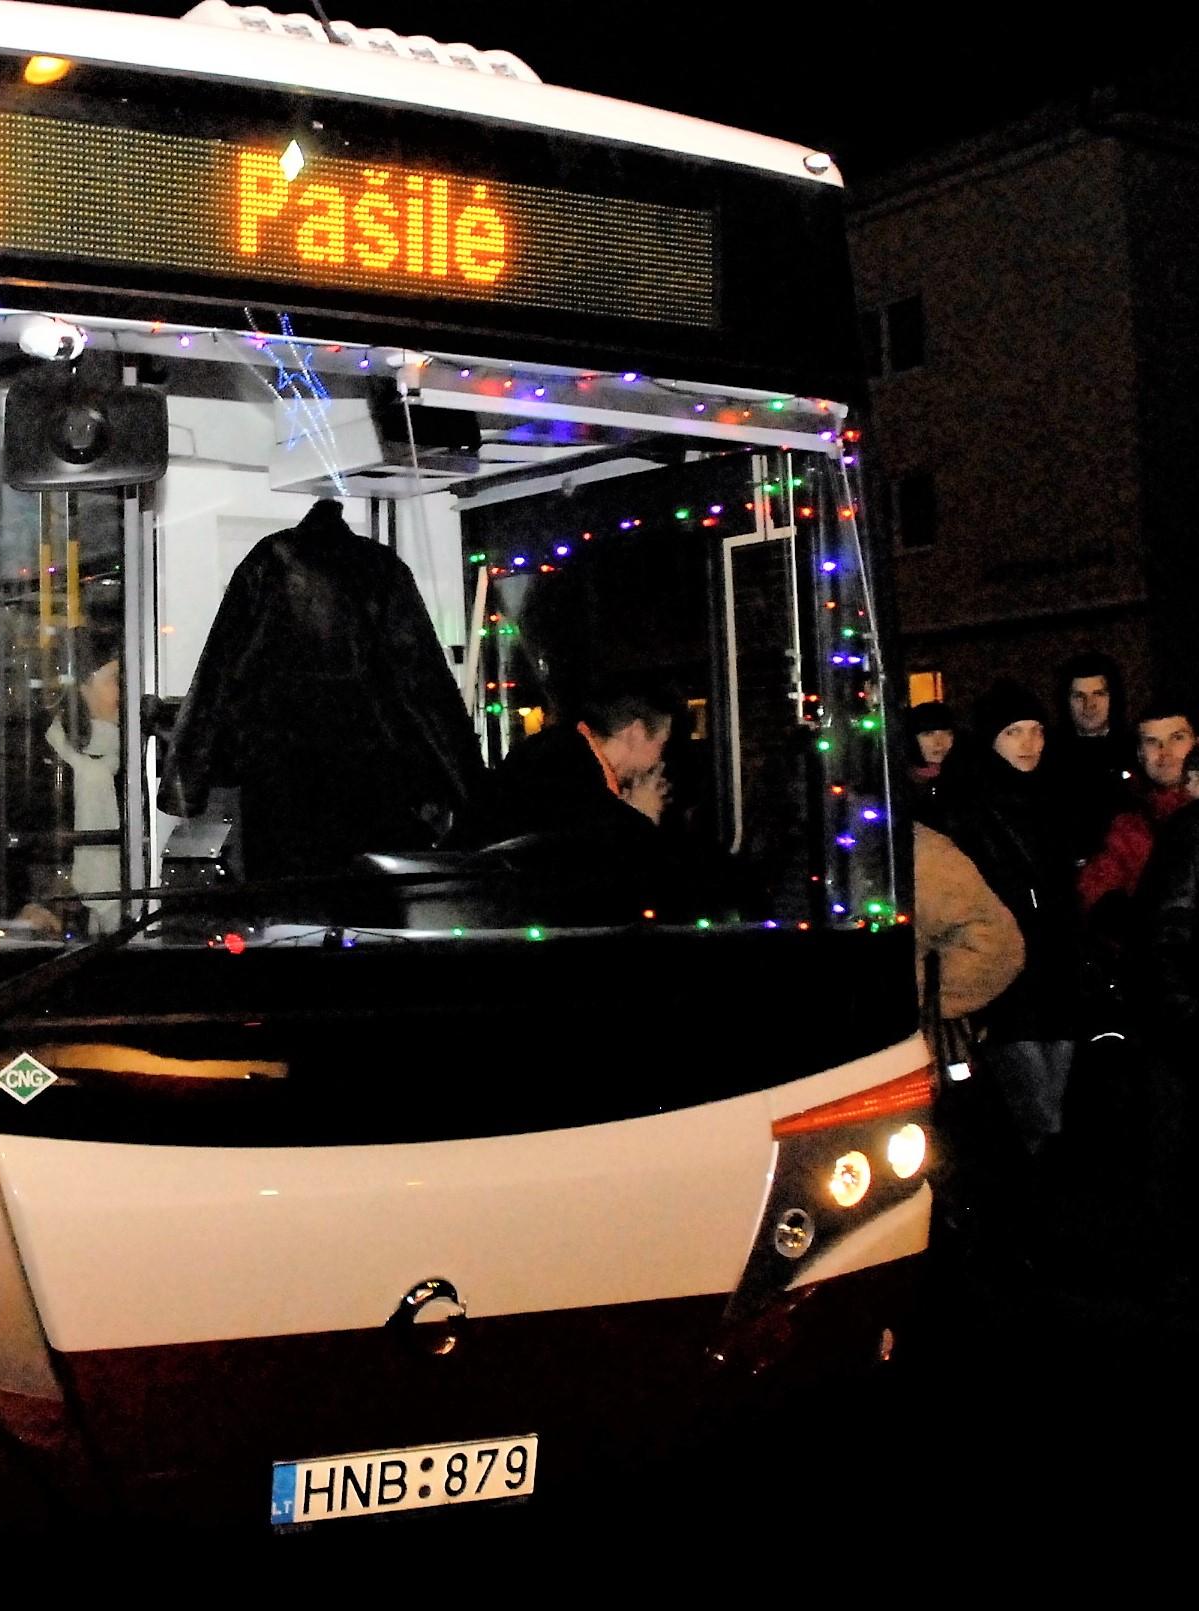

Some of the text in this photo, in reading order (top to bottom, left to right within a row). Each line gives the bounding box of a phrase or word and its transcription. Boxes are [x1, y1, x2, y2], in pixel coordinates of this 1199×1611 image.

[238, 151, 506, 283] Pašilė
[6, 1069, 44, 1089] CNG
[271, 1445, 528, 1516] LT HNB 879
